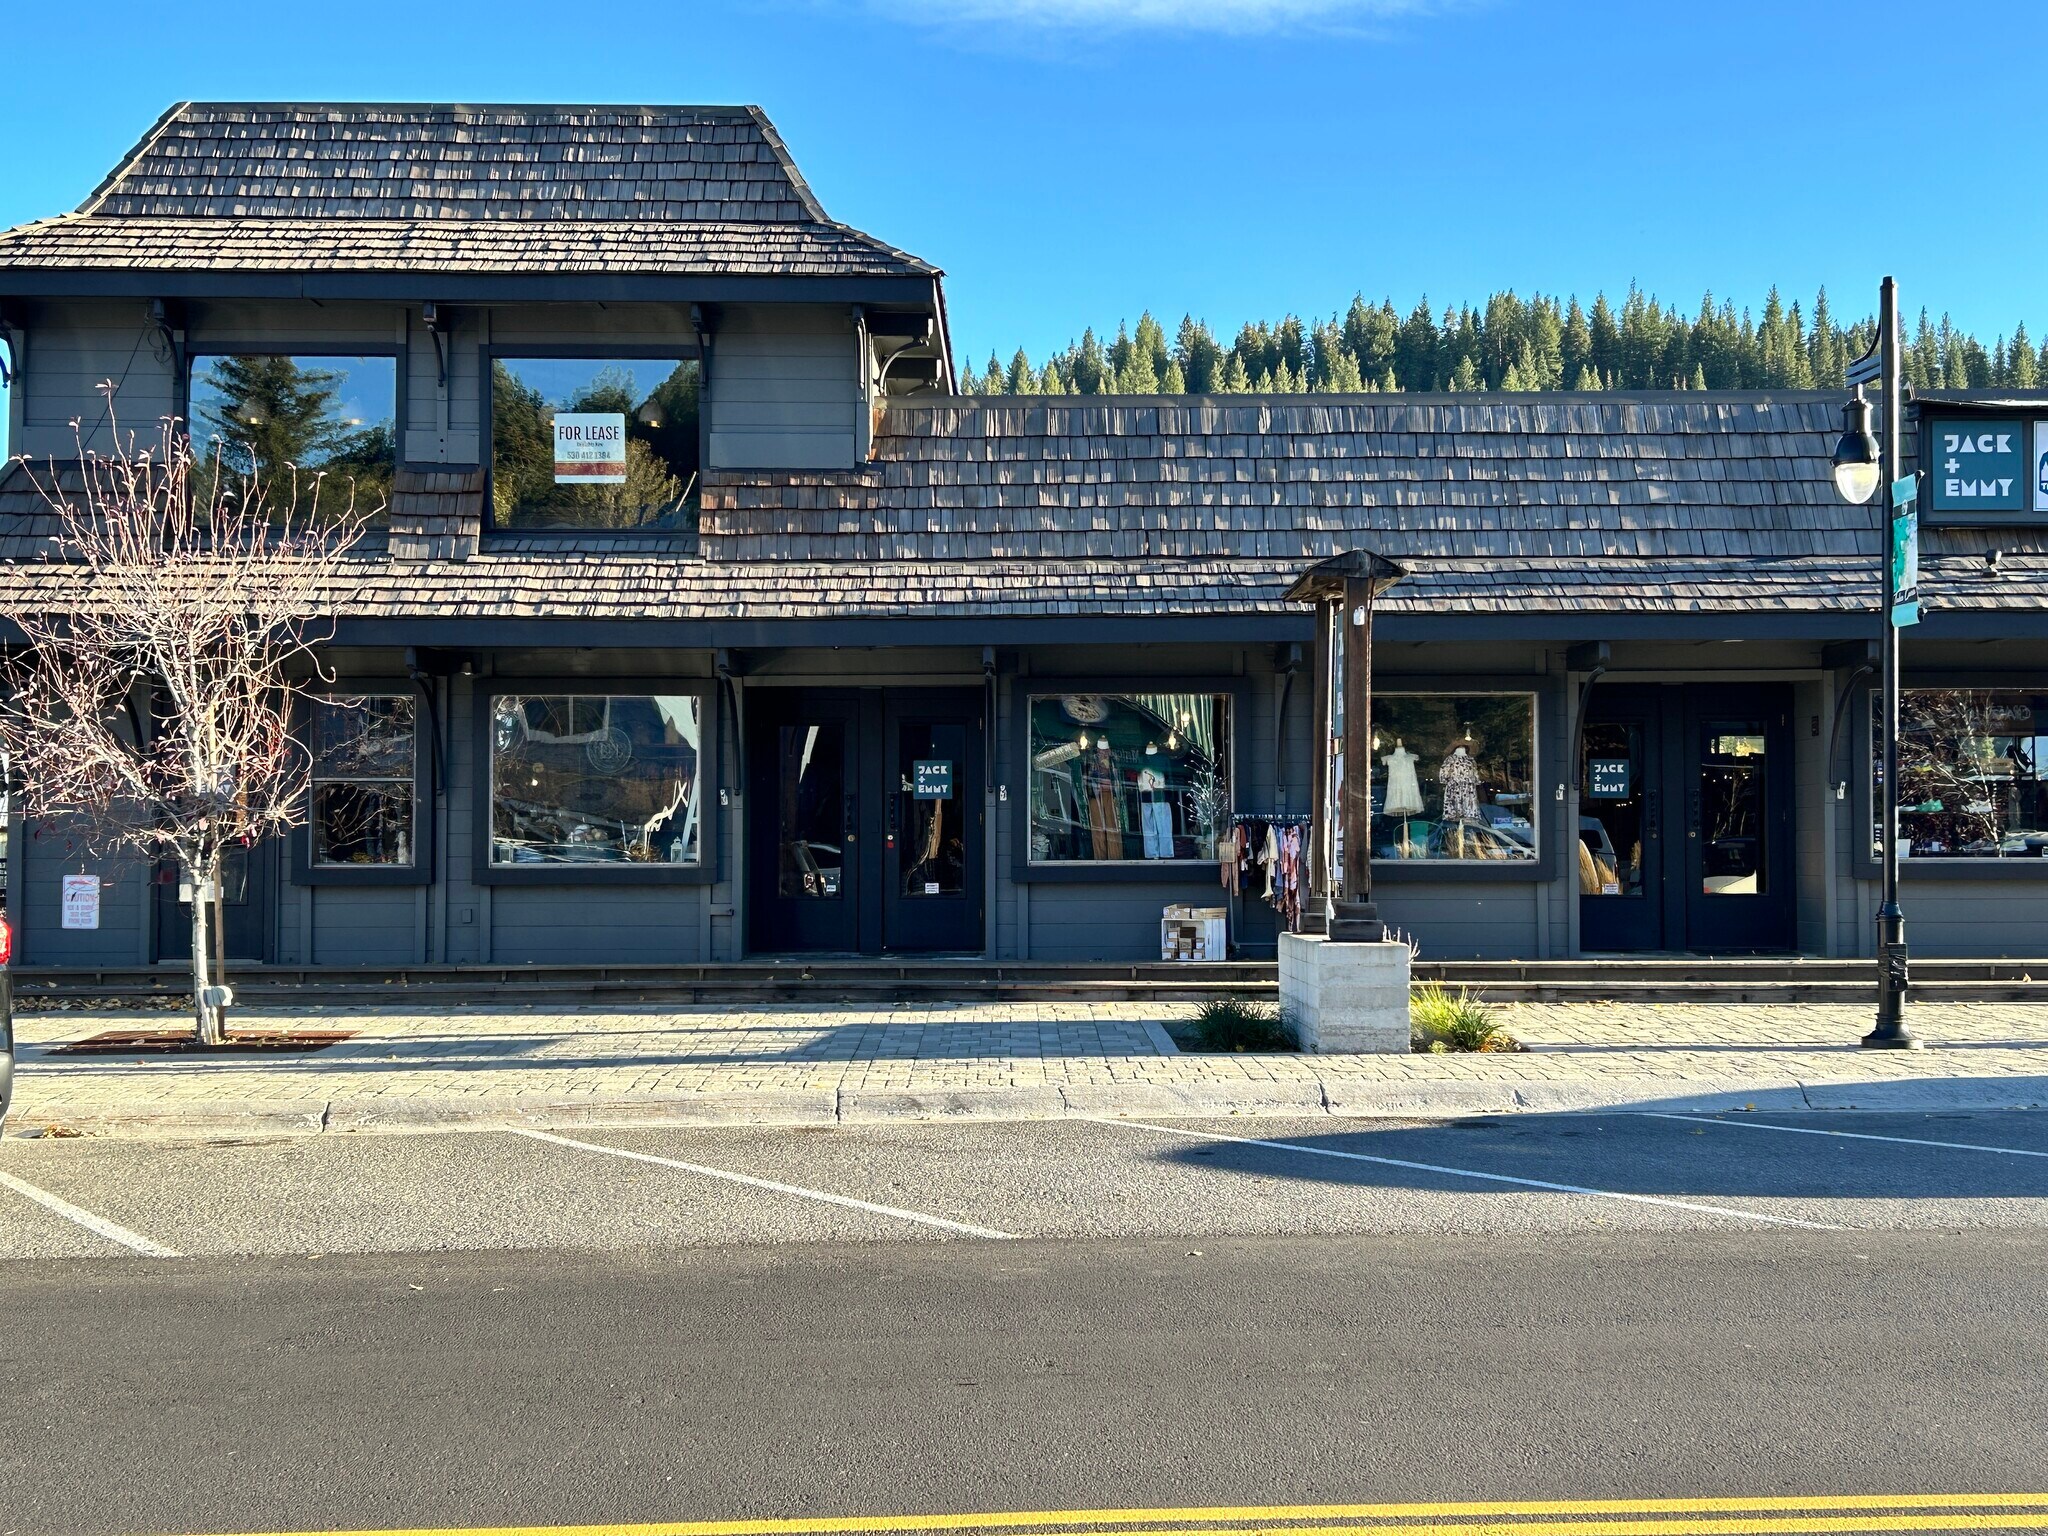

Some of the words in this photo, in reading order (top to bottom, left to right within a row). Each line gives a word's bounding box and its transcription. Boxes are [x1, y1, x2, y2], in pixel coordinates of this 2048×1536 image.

[559, 426, 581, 440] FOR
[586, 426, 619, 440] LEASE
[1944, 435, 2012, 452] JACK
[1944, 458, 1960, 474] +
[1946, 479, 2013, 496] EMMY
[918, 766, 948, 774] JACK
[1594, 764, 1624, 773] JACK
[918, 785, 948, 793] EMMY
